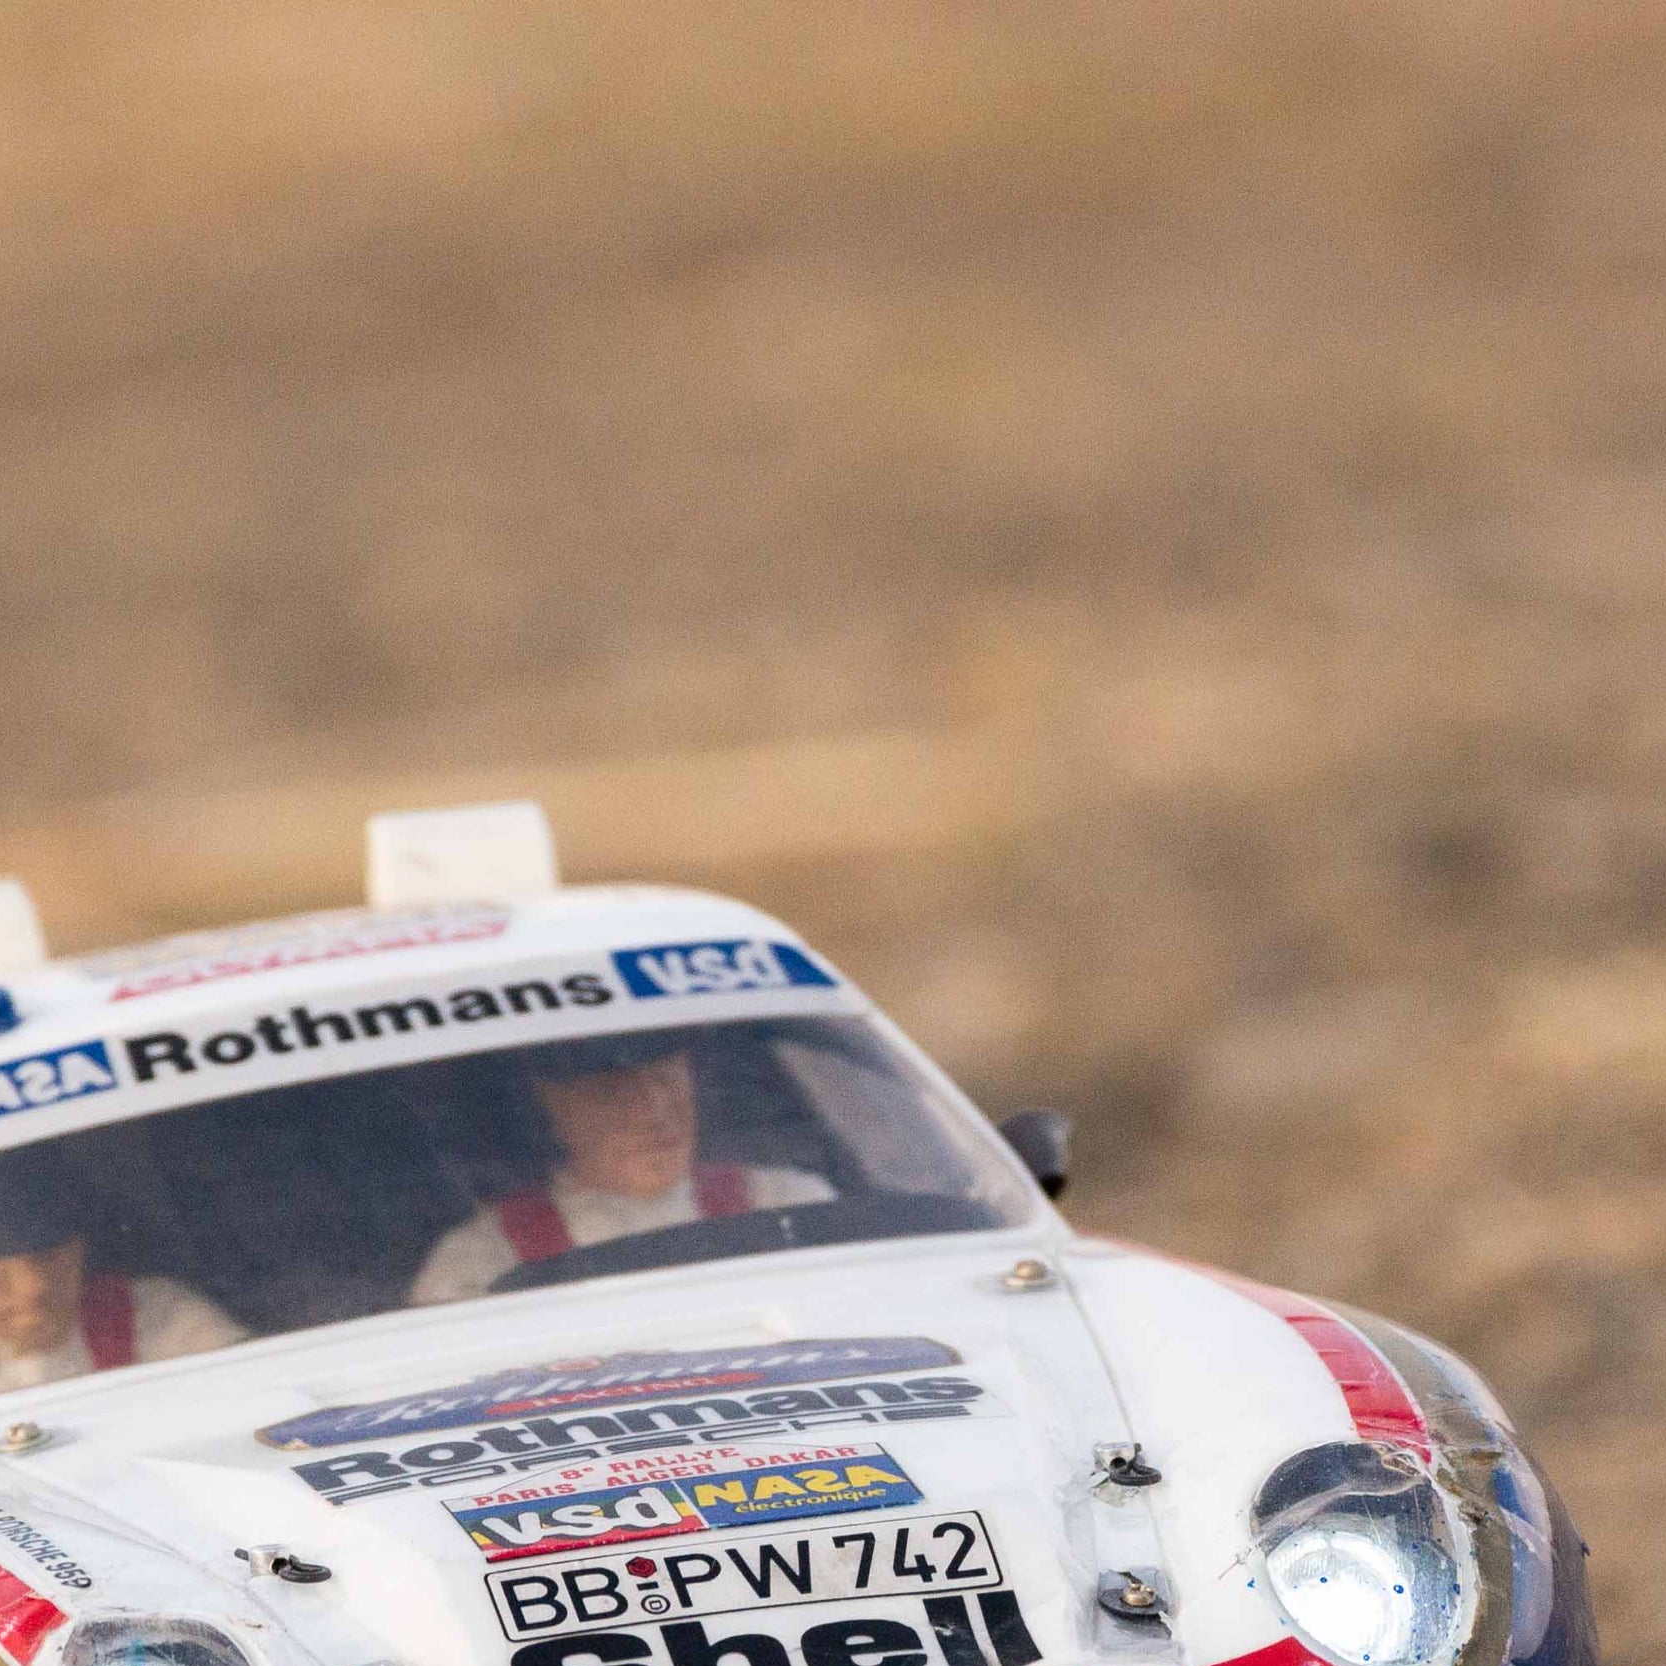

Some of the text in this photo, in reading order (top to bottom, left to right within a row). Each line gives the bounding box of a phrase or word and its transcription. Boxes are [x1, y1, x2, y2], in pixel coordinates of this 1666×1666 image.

[125, 966, 615, 1083] Rothmans
[290, 1376, 985, 1492] Rothmans
[608, 1447, 740, 1473] RALLYE
[473, 1446, 859, 1507] PARIS ALGER DAKAR
[693, 1464, 909, 1508] NASA
[46, 1561, 93, 1589] 959
[831, 1521, 989, 1590] 742
